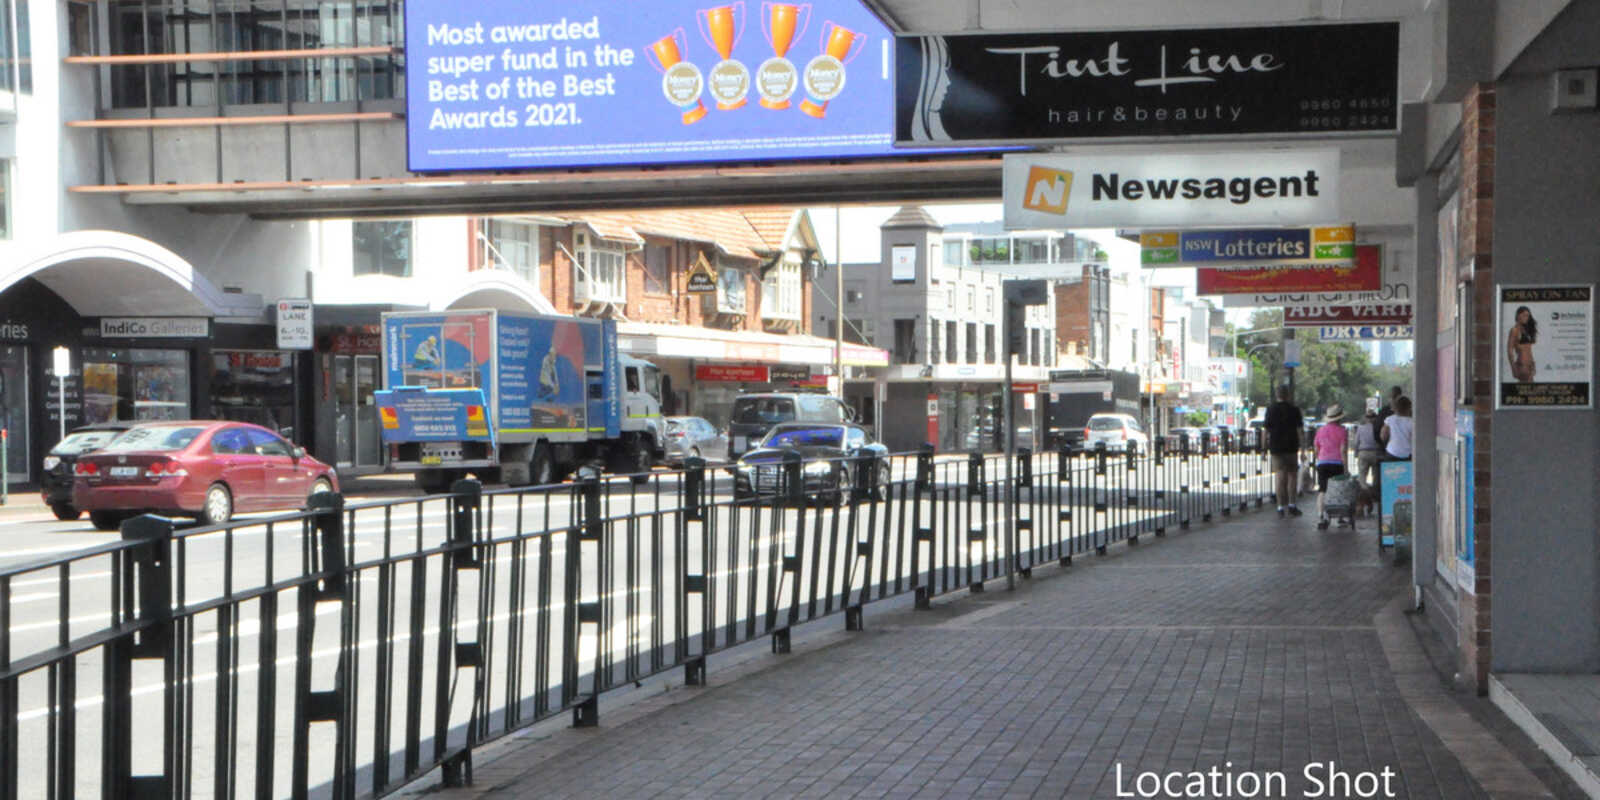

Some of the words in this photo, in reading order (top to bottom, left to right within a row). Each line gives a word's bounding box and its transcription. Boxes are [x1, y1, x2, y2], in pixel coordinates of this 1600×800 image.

[427, 22, 485, 46] Most
[491, 16, 600, 43] awarded
[427, 55, 495, 78] super
[501, 47, 559, 71] fund
[565, 46, 588, 68] in
[594, 44, 635, 67] the
[985, 41, 1131, 96] Tint
[1134, 44, 1285, 94] Line
[428, 78, 480, 102] Best
[486, 76, 511, 100] of
[516, 75, 557, 99] the
[563, 72, 616, 97] Best
[428, 106, 518, 130] Awards
[525, 102, 582, 127] 2021.
[1092, 170, 1320, 204] Newsagent
[1185, 239, 1212, 252] NSW
[1214, 236, 1305, 258] Lotteries
[1506, 290, 1540, 300] SPRAY
[104, 322, 147, 335] IndiCo
[1324, 326, 1362, 338] DRY
